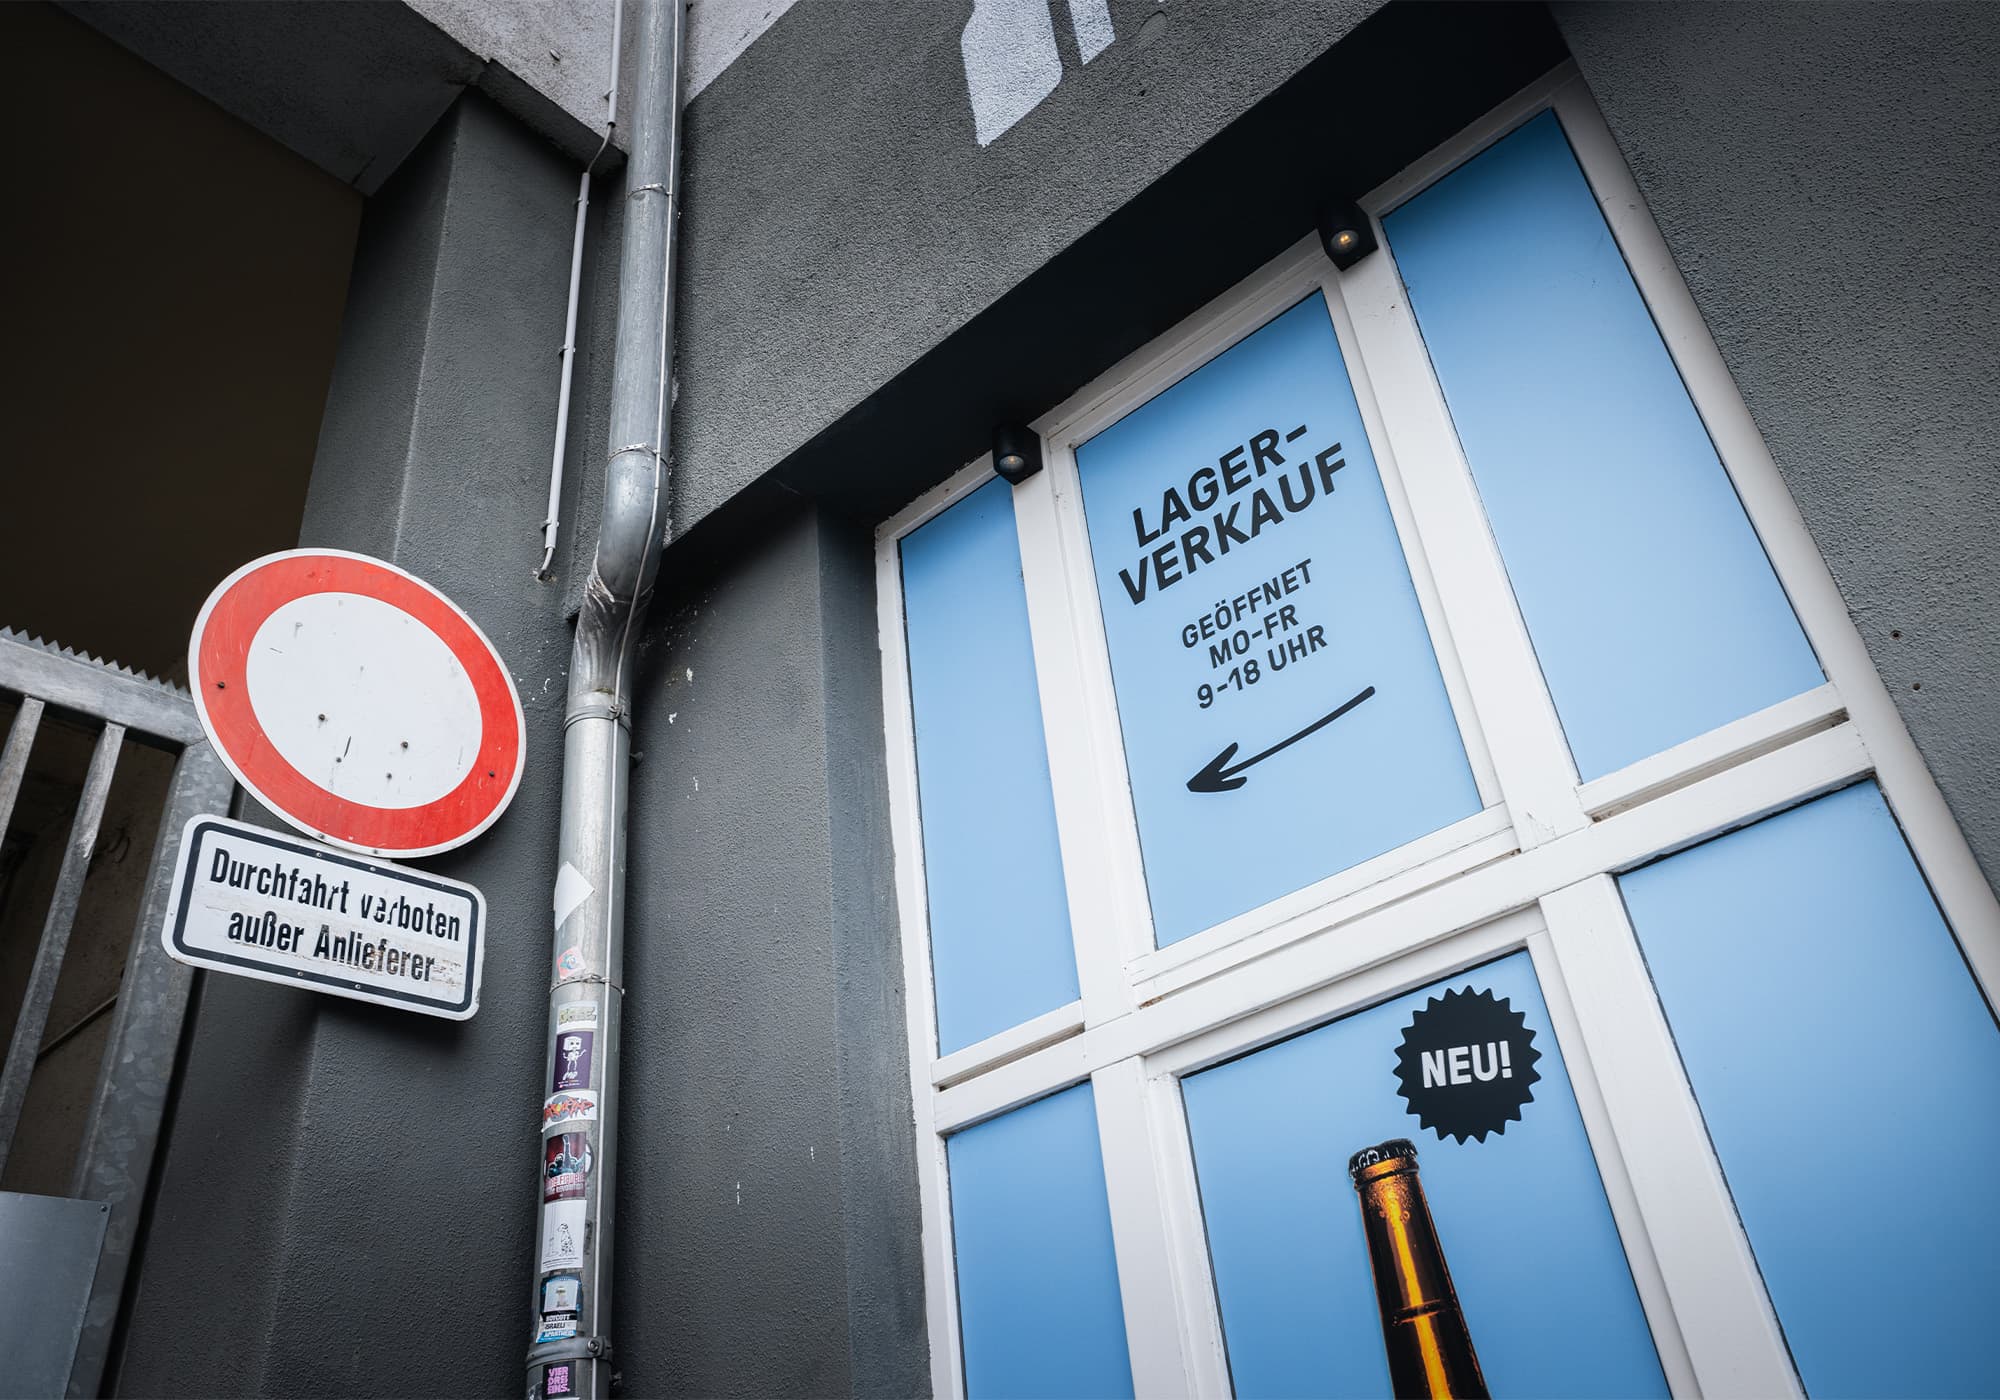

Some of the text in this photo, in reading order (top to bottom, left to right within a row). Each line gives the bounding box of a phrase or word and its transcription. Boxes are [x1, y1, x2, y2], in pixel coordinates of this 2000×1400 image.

[1118, 442, 1346, 606] VERKAUF
[1132, 423, 1308, 548] LAGER-
[1182, 558, 1312, 649] GEÖFFNET
[1208, 604, 1299, 669] MO-FR
[1197, 625, 1328, 709] 9-18 UHR
[210, 847, 460, 942] Durchfahrt verboten
[227, 910, 436, 982] außer Anlieferer
[1421, 1040, 1513, 1089] NEU!
